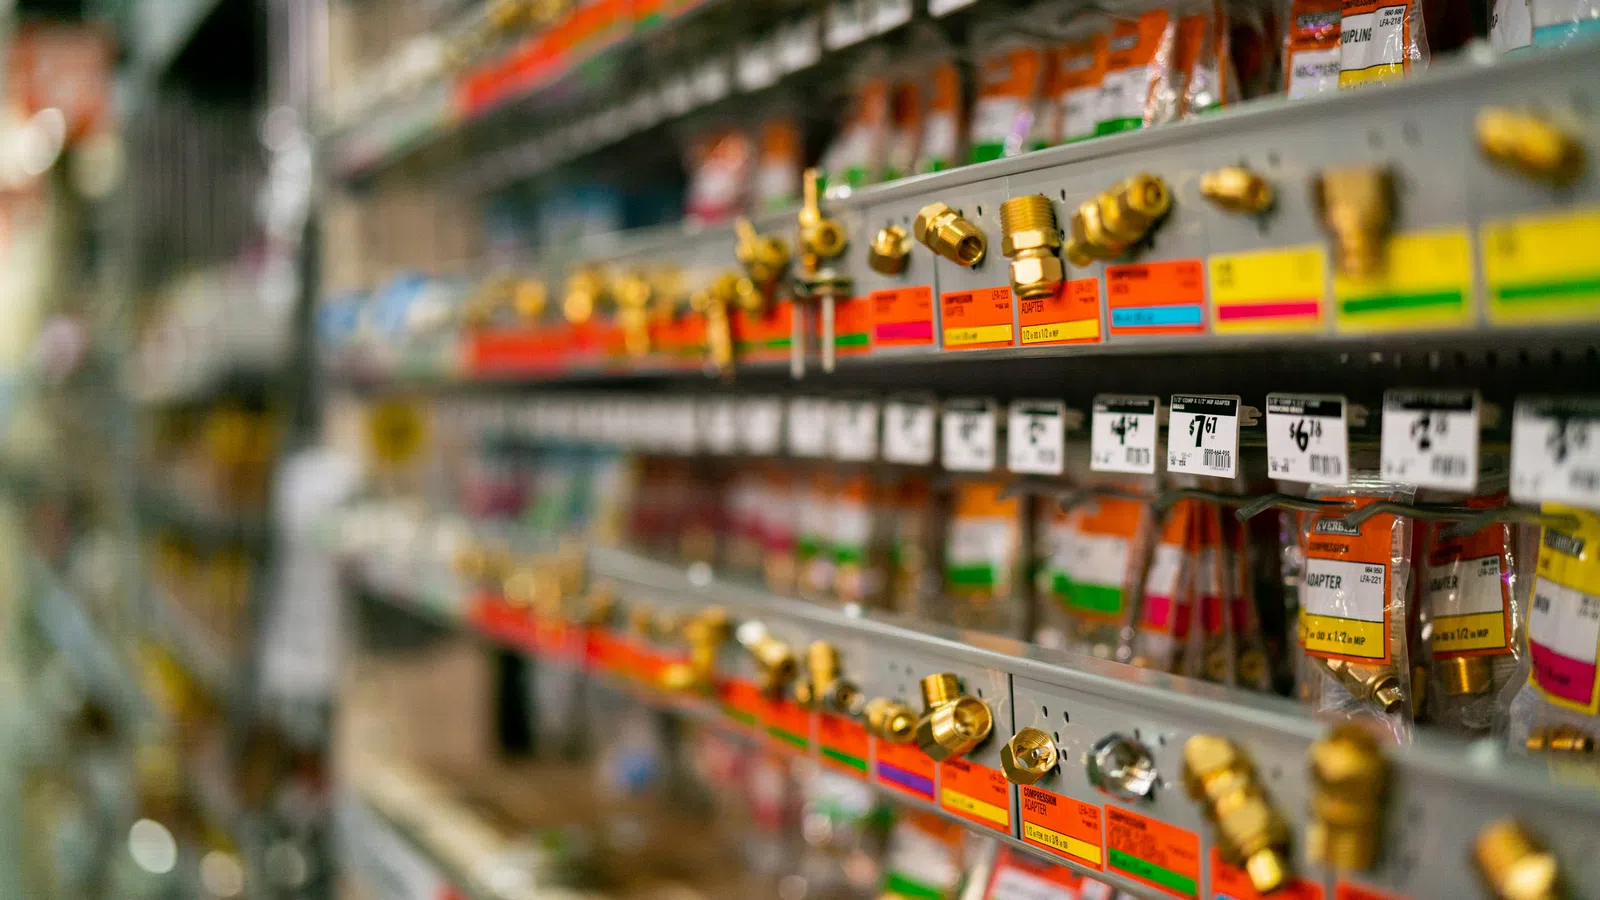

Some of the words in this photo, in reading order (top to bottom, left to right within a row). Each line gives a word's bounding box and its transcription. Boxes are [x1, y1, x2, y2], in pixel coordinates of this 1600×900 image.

[1379, 17, 1402, 27] LFA-218
[1341, 27, 1372, 45] OUPLING
[1021, 300, 1045, 314] ADAPTER
[1315, 519, 1358, 533] EVERB
[1360, 575, 1382, 584] LFA-221
[1024, 786, 1057, 806] COMPRESSION
[1024, 798, 1048, 816] ADAPTER
